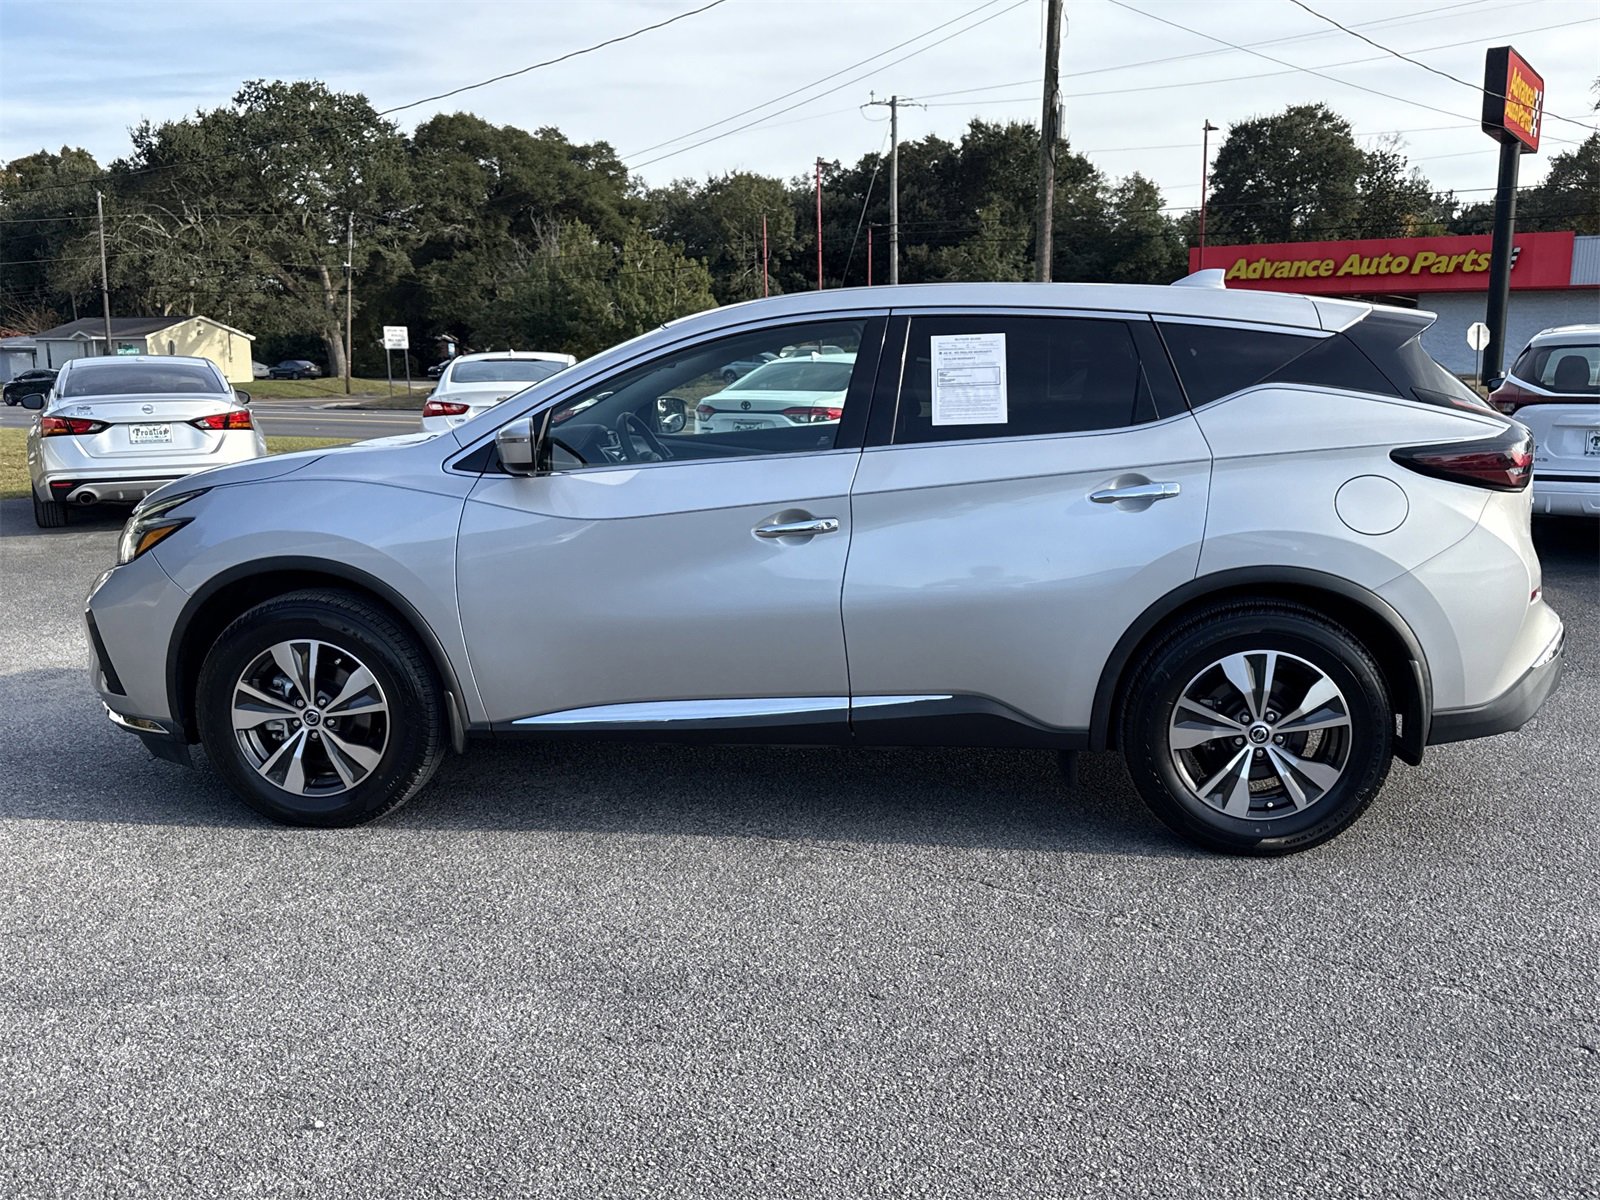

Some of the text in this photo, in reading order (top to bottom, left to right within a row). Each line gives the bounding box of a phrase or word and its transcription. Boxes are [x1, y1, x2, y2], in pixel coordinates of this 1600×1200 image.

[1225, 249, 1491, 280] Advance Auto Parts
